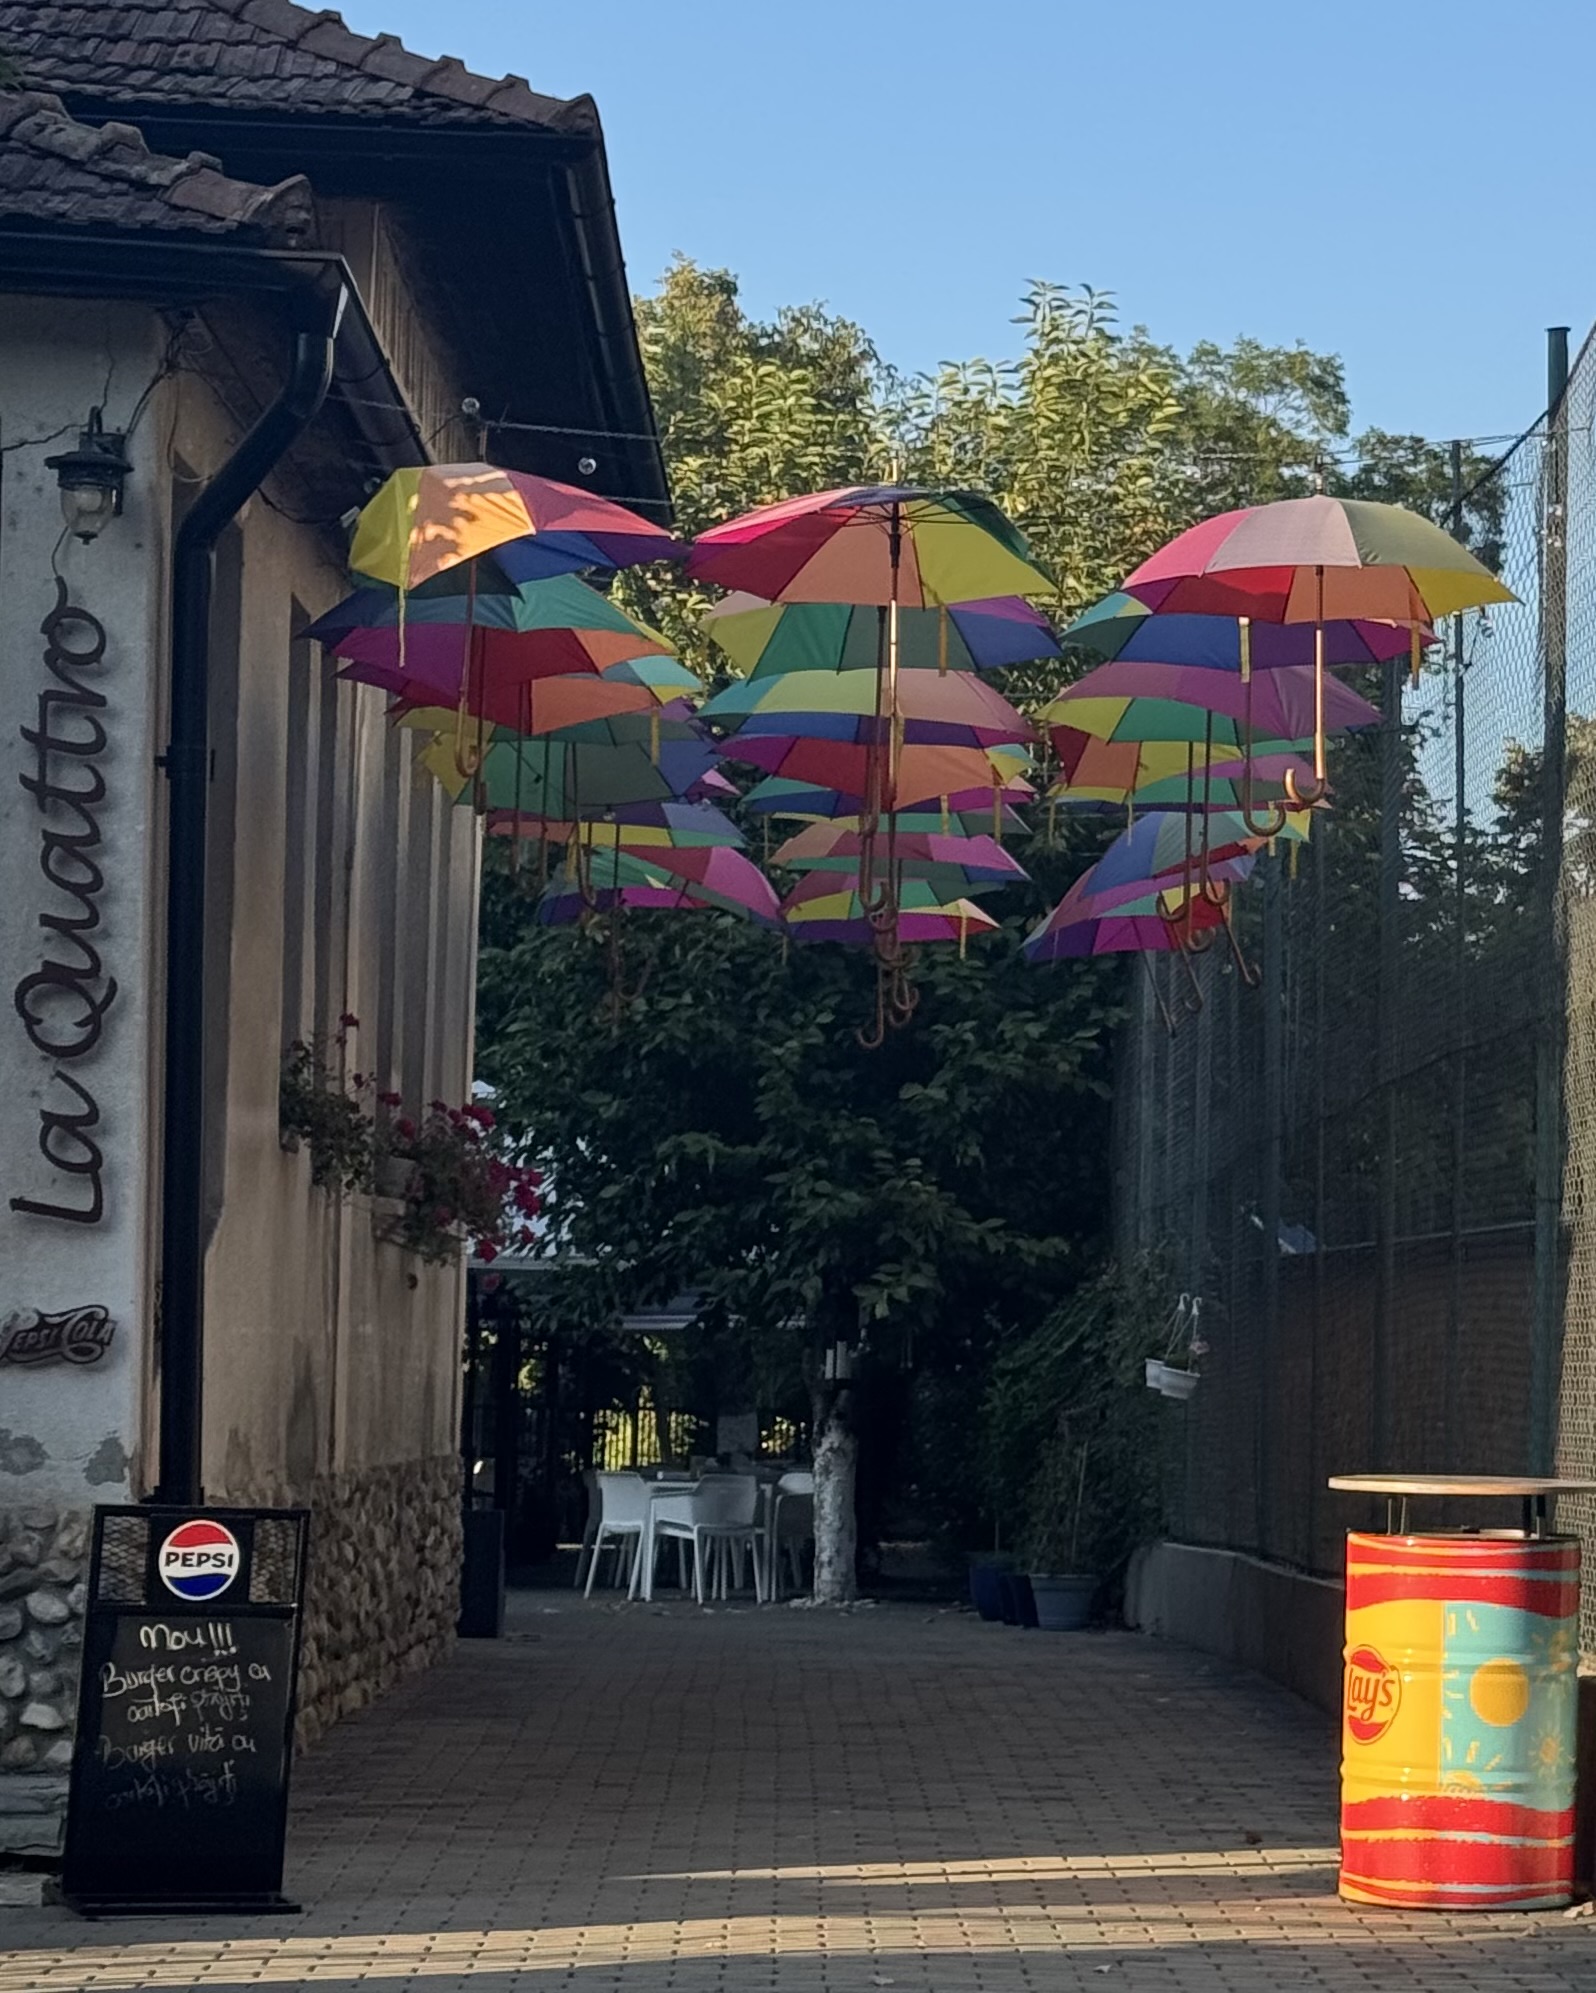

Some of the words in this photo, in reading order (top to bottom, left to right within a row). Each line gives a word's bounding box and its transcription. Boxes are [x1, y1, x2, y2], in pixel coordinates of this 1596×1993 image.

[15, 576, 118, 1058] Quattro
[8, 1070, 103, 1224] La
[164, 1551, 234, 1569] PEPSI
[102, 1661, 175, 1699] Burger
[180, 1663, 241, 1693] crispy
[1346, 1667, 1396, 1722] Lay's
